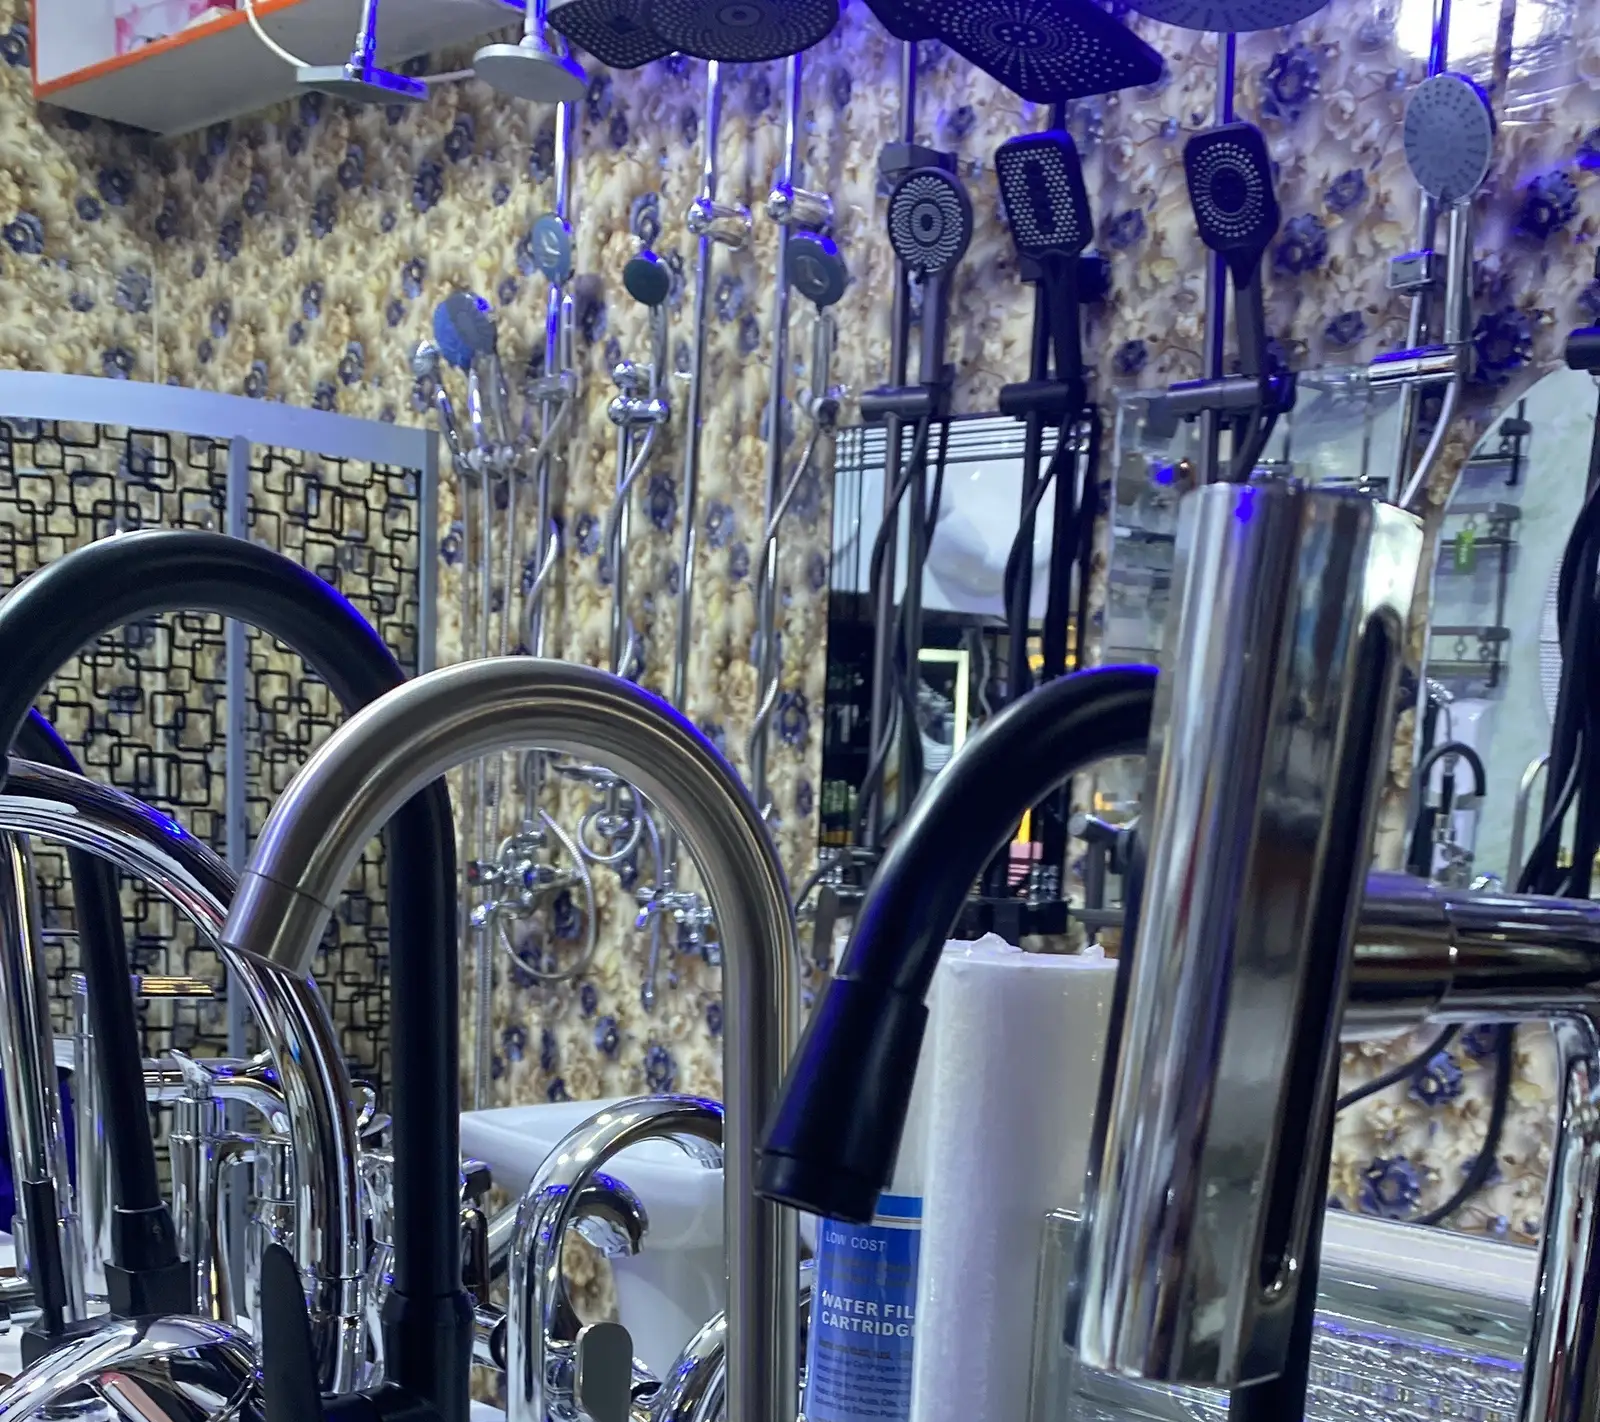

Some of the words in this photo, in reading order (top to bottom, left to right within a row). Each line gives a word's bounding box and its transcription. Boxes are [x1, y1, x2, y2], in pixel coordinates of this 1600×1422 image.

[826, 1231, 846, 1246] LOW
[850, 1237, 886, 1252] COST
[822, 1292, 878, 1317] WATER
[884, 1303, 915, 1320] FIL
